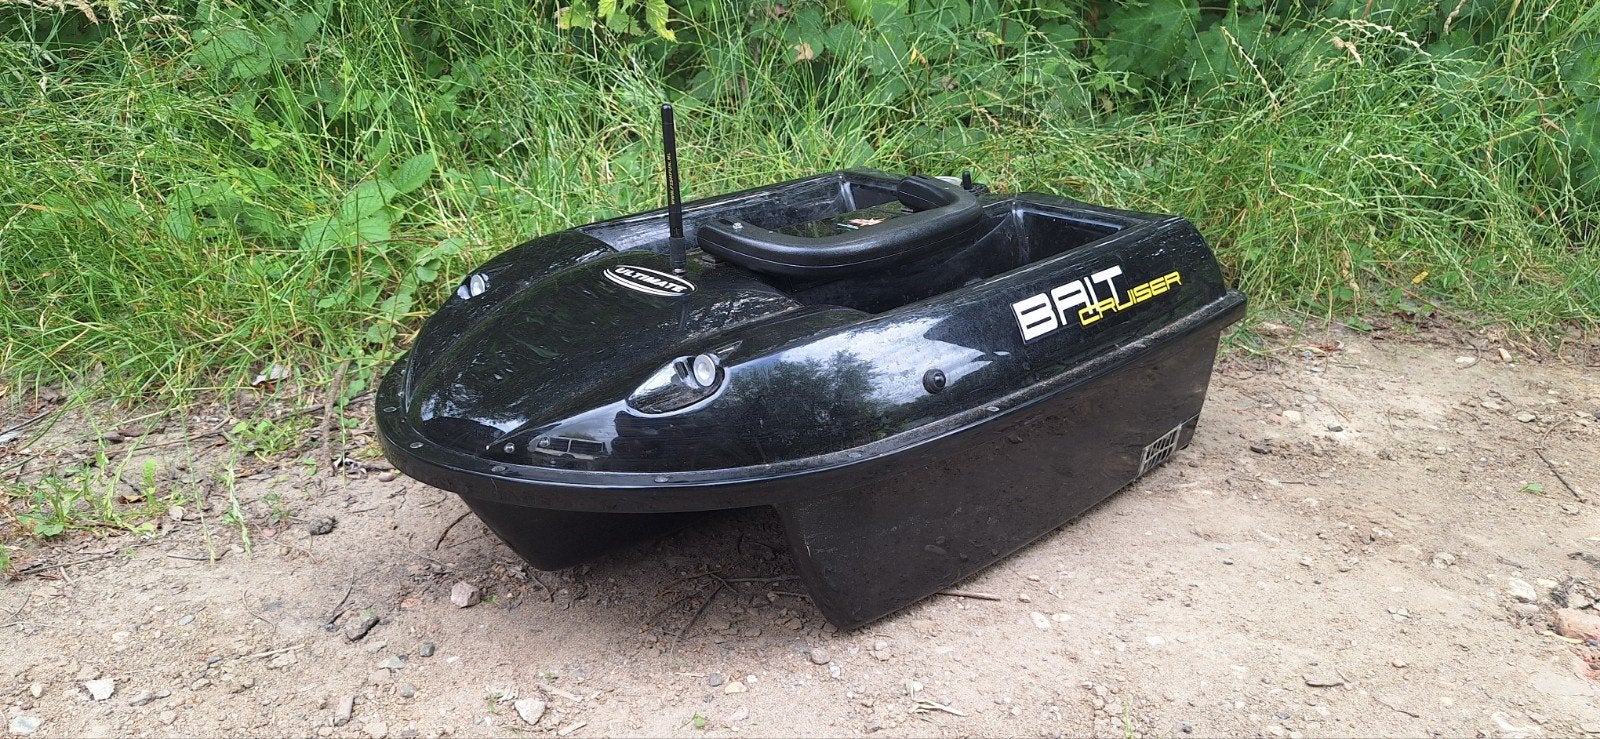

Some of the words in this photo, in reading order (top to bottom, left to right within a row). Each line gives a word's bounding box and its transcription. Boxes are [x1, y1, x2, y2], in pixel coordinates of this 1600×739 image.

[614, 267, 688, 293] ULTIMATE
[1012, 265, 1122, 341] BAIT
[1078, 271, 1182, 326] CRUISER
